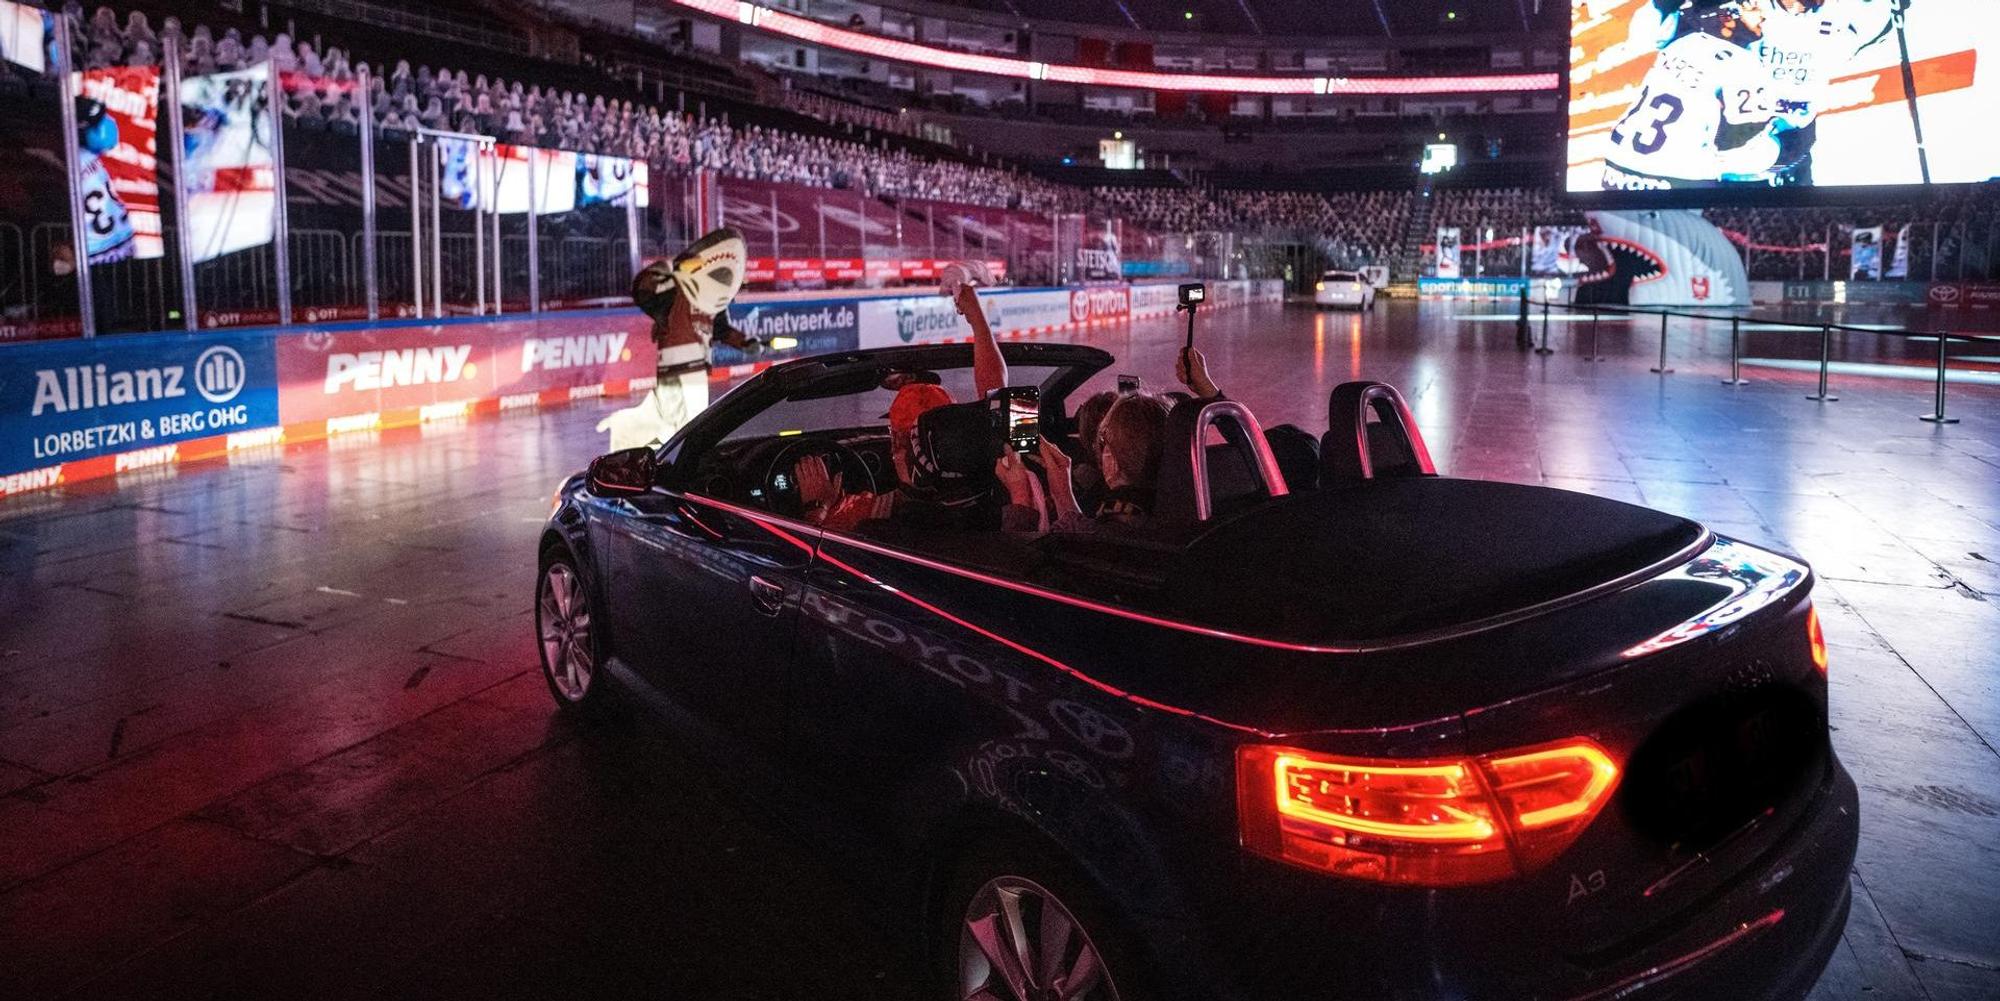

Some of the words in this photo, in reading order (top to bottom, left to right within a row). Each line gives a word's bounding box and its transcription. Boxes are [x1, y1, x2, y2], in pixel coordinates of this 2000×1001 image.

[1090, 287, 1128, 314] TOYOTA
[31, 363, 186, 416] Allianz
[33, 424, 136, 459] LORBETZKI
[141, 418, 155, 440] &
[160, 410, 204, 436] BERG
[208, 405, 248, 428] OHG
[1567, 869, 1606, 906] A3
